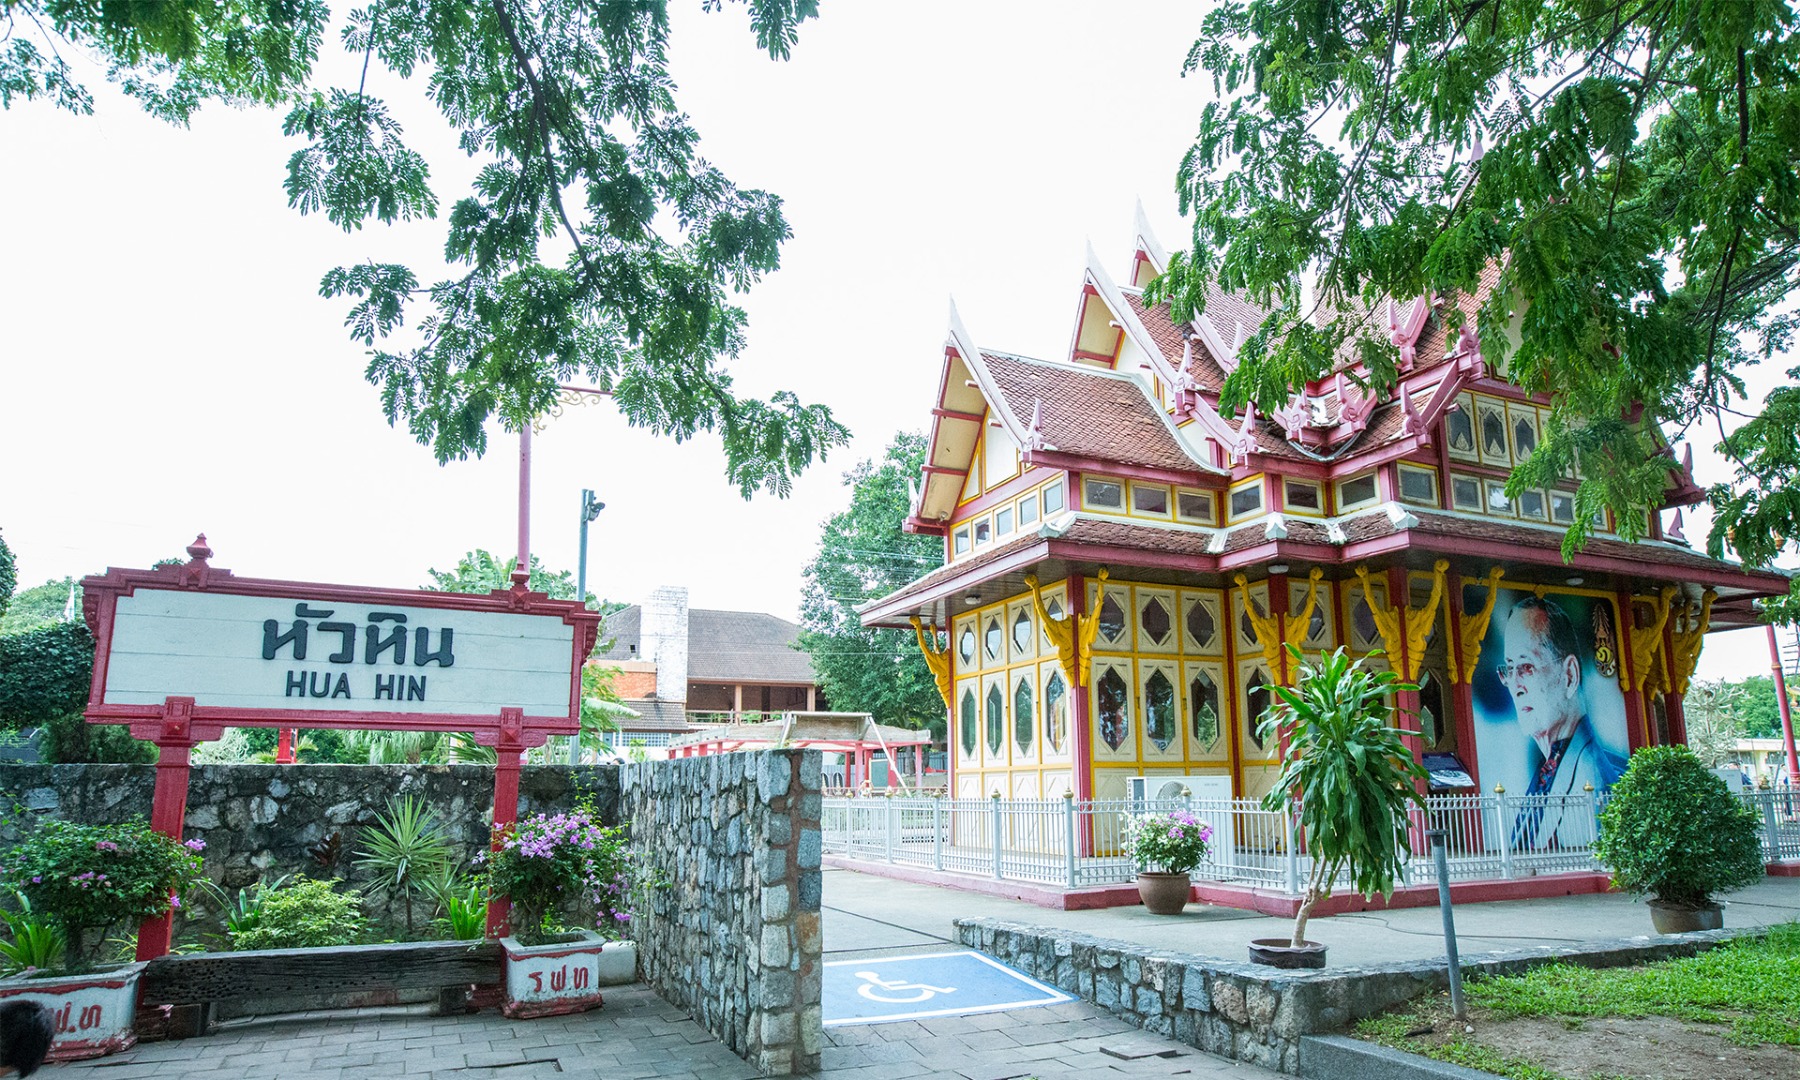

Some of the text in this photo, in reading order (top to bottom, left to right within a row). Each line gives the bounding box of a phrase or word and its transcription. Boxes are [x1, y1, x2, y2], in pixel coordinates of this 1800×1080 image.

[262, 602, 454, 668] หัวหิน
[285, 670, 427, 701] HUA HIN
